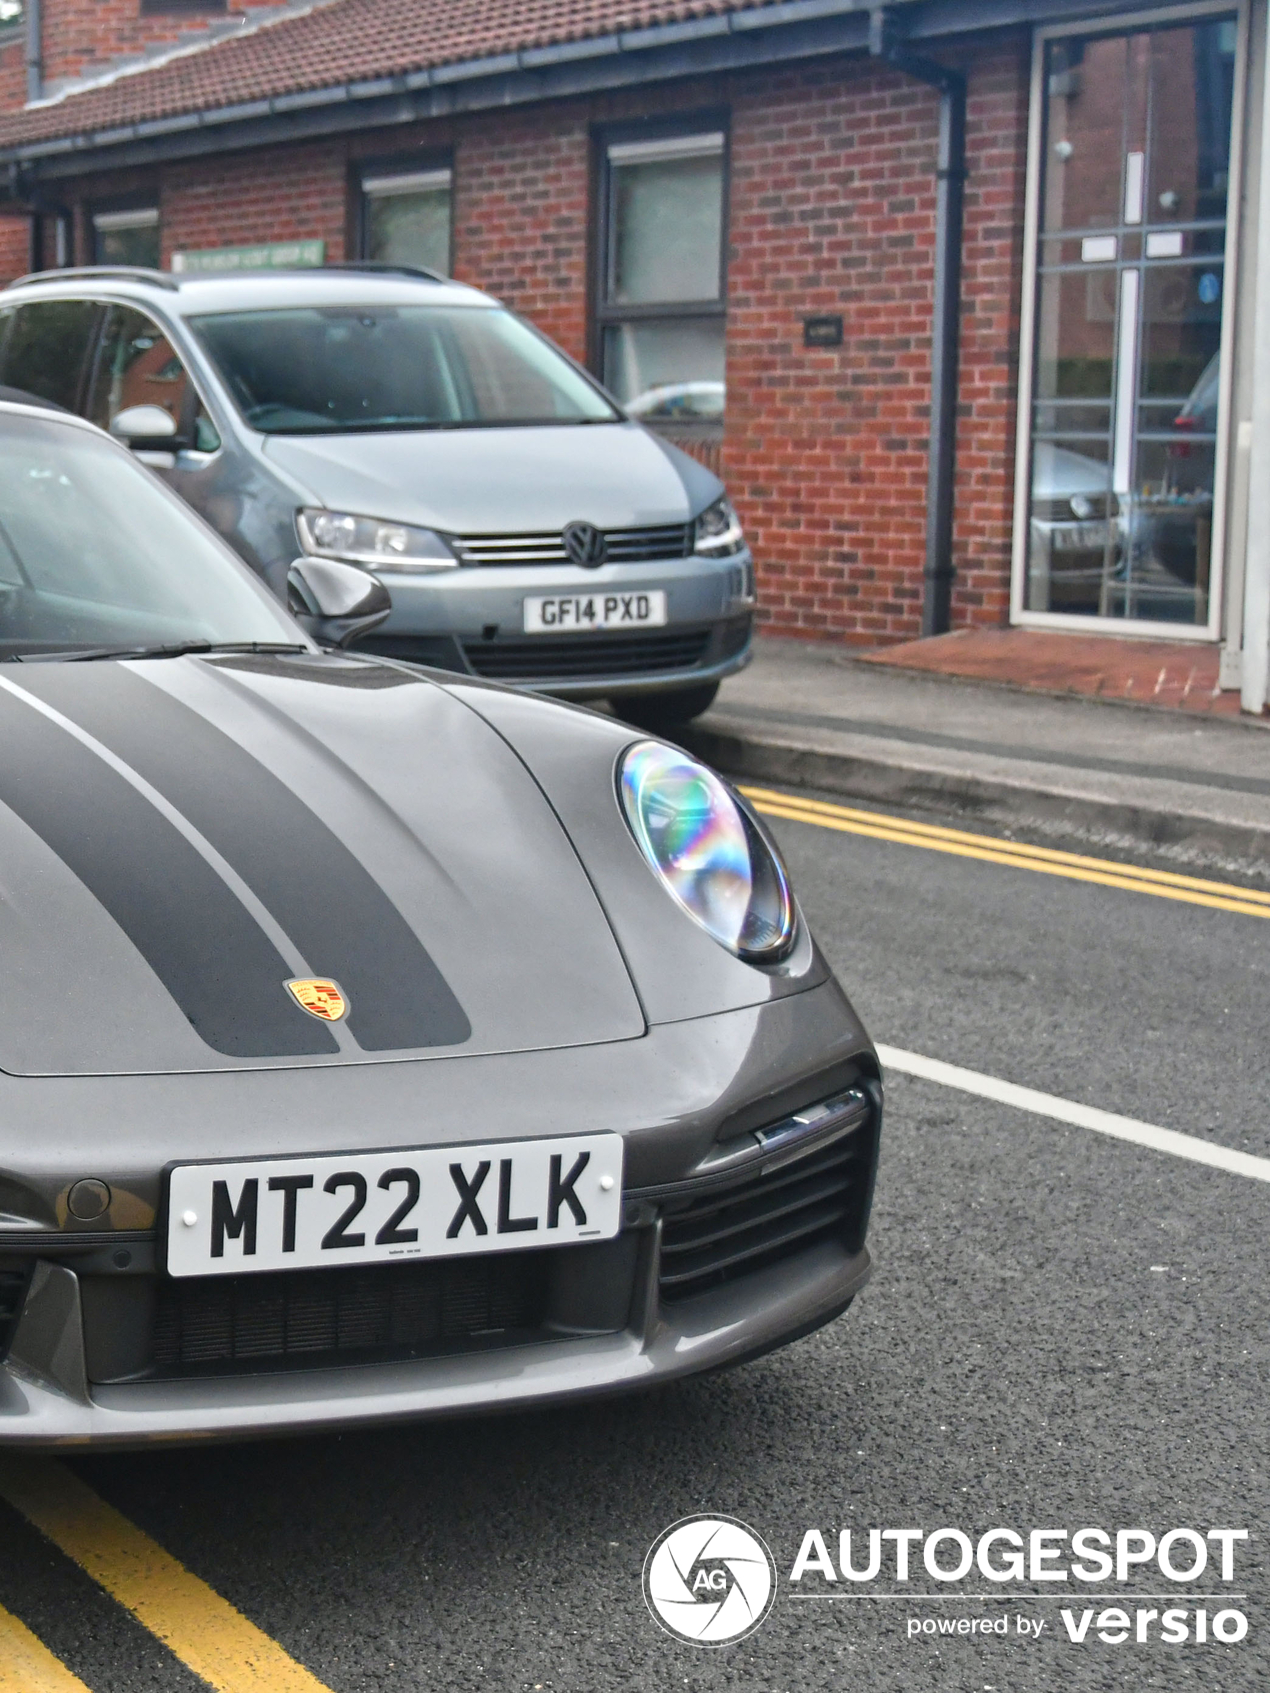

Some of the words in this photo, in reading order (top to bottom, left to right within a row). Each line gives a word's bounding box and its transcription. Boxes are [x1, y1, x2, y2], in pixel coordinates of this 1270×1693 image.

[541, 598, 595, 625] GF14
[603, 595, 649, 622] PXD
[210, 1166, 420, 1258] MT22
[445, 1151, 591, 1239] XLK
